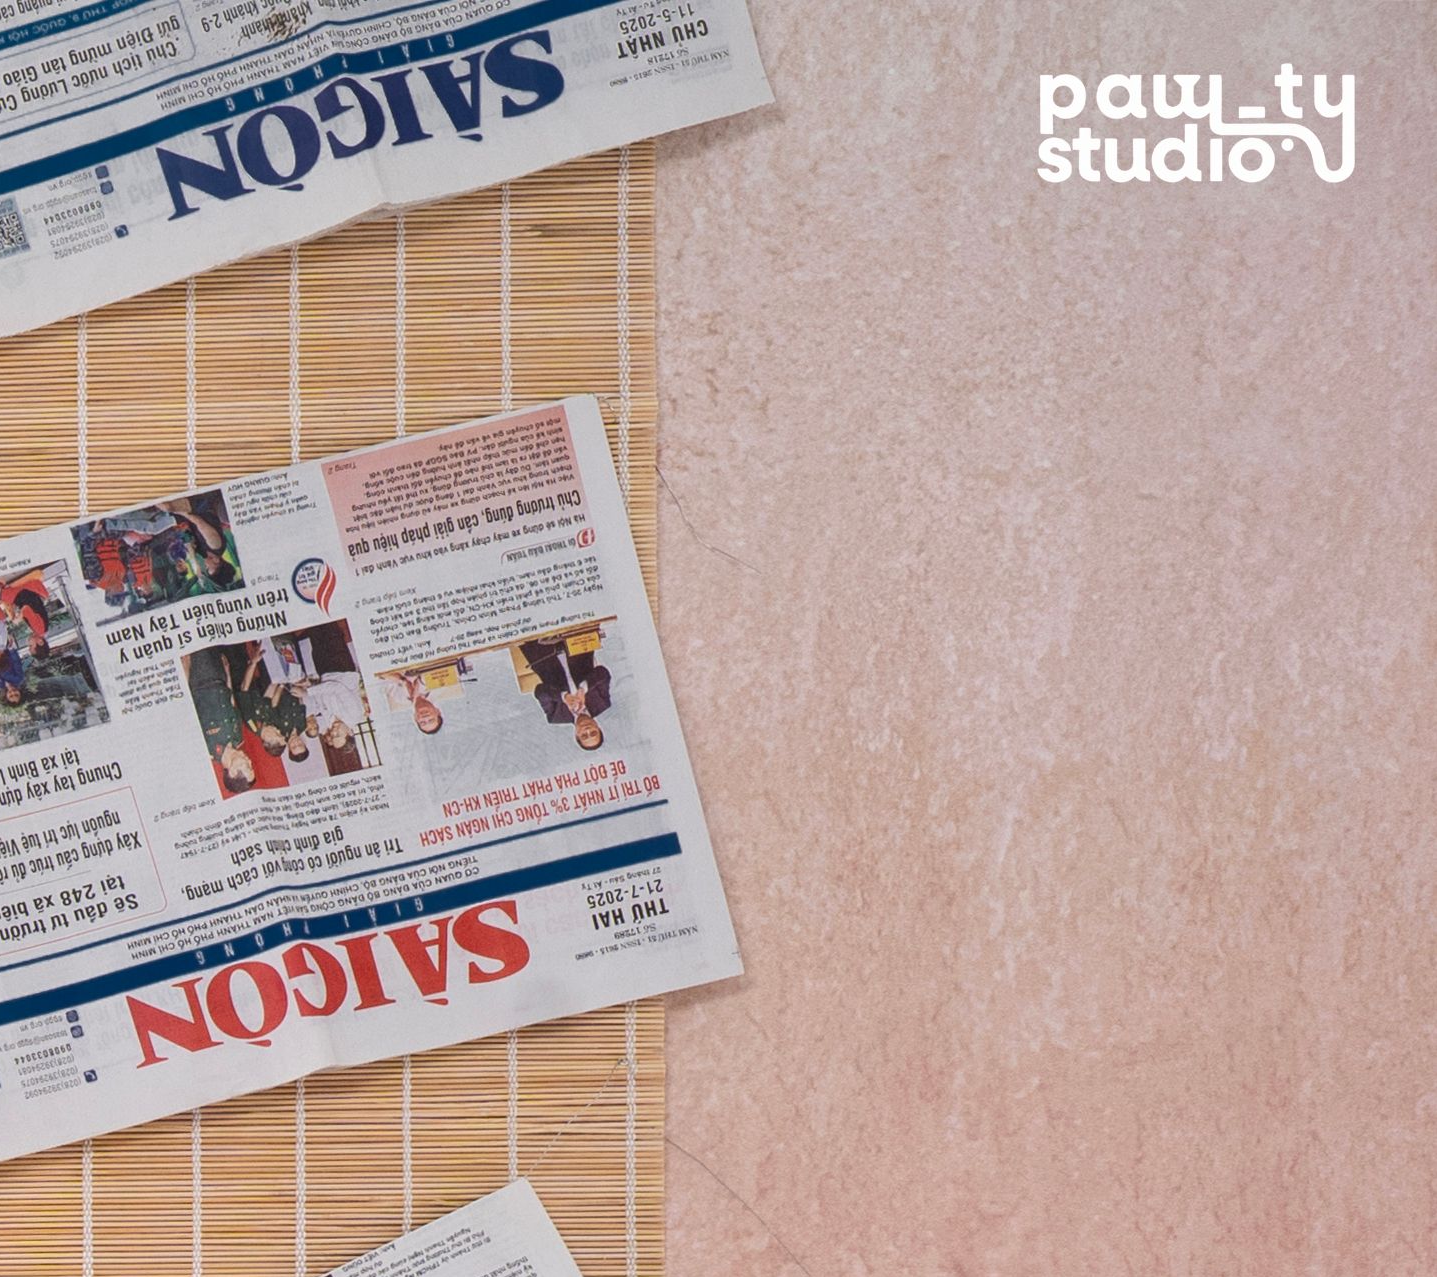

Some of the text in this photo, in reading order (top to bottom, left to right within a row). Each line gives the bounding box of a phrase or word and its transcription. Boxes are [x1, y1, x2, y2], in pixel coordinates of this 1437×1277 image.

[619, 3, 694, 34] 11-5-2025
[618, 19, 708, 59] CHỦ NHẬT
[112, 52, 142, 76] tịch
[146, 41, 177, 65] Chủ
[18, 71, 68, 102] Lương
[71, 60, 108, 87] nước
[113, 893, 138, 912] Sẽ
[587, 879, 663, 909] 21-7-2025
[50, 913, 69, 930] tư
[73, 902, 107, 922] đầu
[592, 898, 669, 930] THỨ HAI
